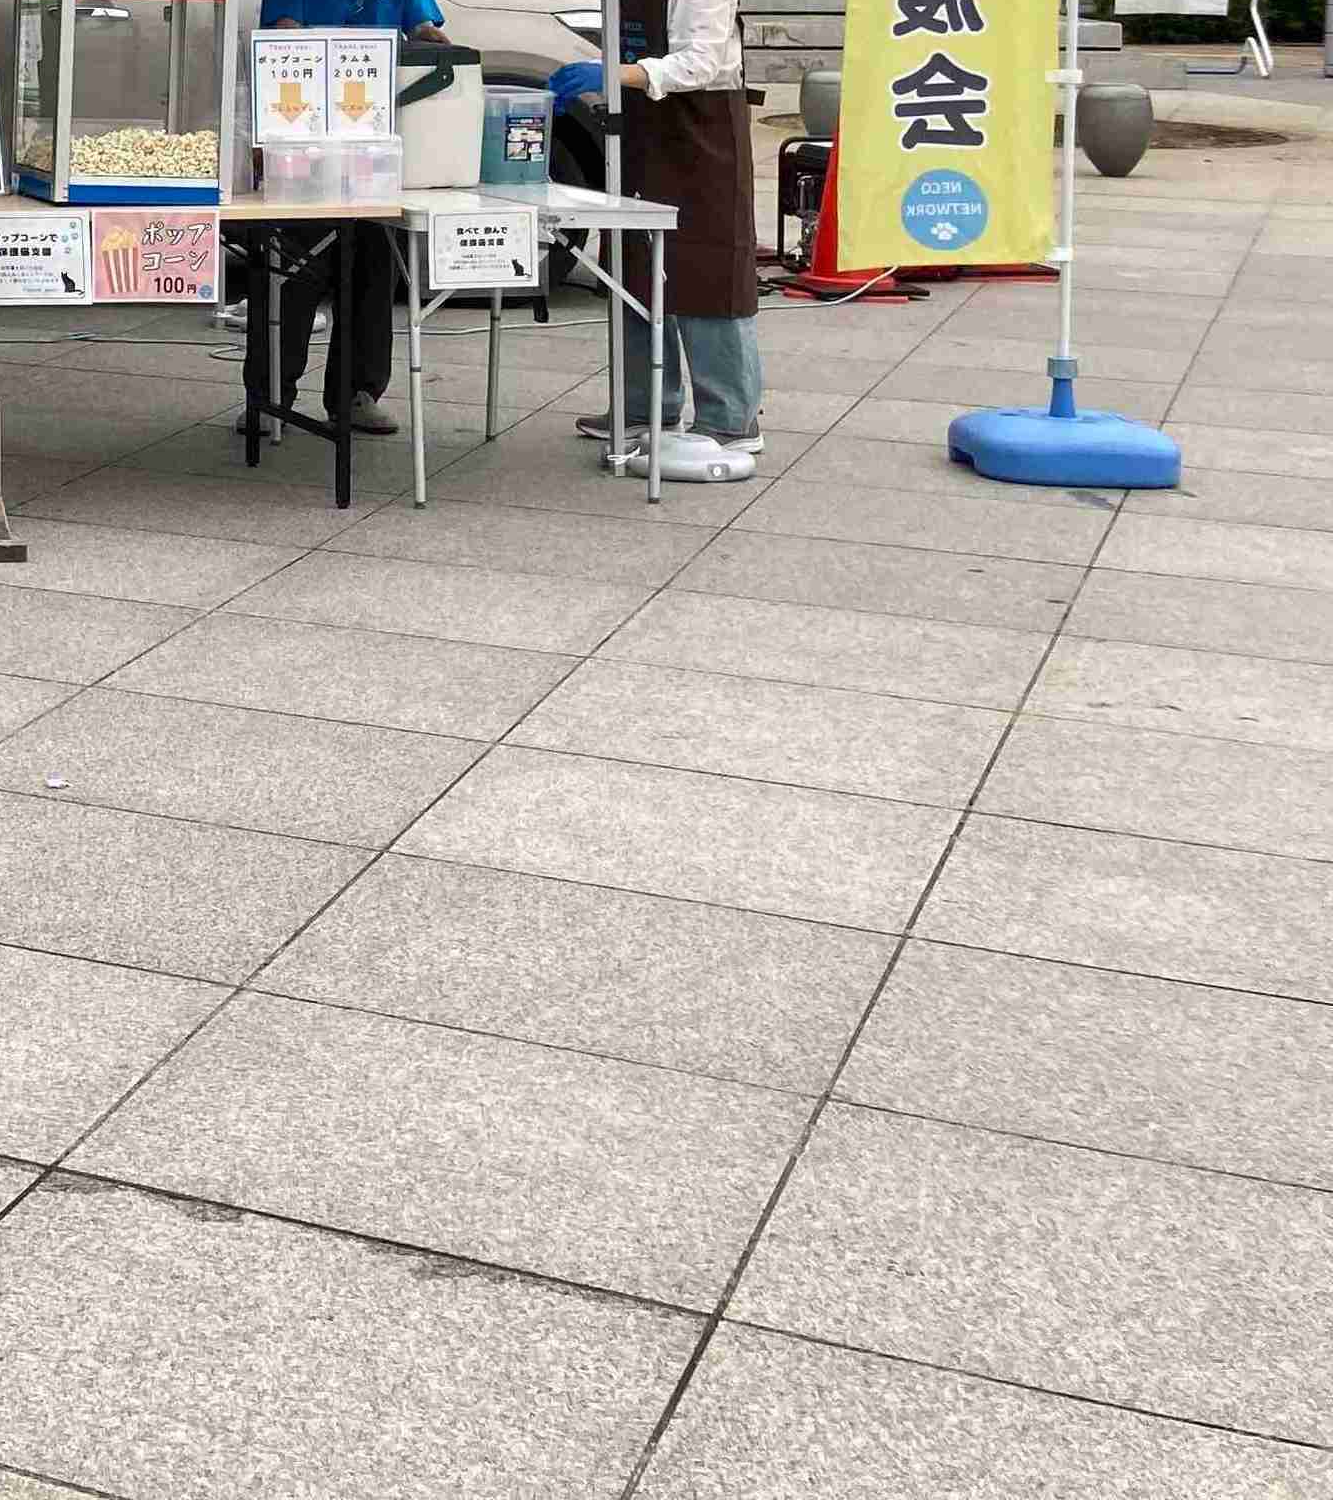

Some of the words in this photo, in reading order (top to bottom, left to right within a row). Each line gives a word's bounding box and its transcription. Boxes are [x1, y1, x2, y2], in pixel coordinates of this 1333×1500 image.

[258, 53, 323, 65] ポップコーン
[340, 53, 372, 64] ラムネ
[271, 68, 313, 79] 100円
[333, 68, 377, 78] 200円
[142, 221, 213, 245] ポップ
[142, 250, 209, 272] コーン
[154, 277, 197, 293] 100円
